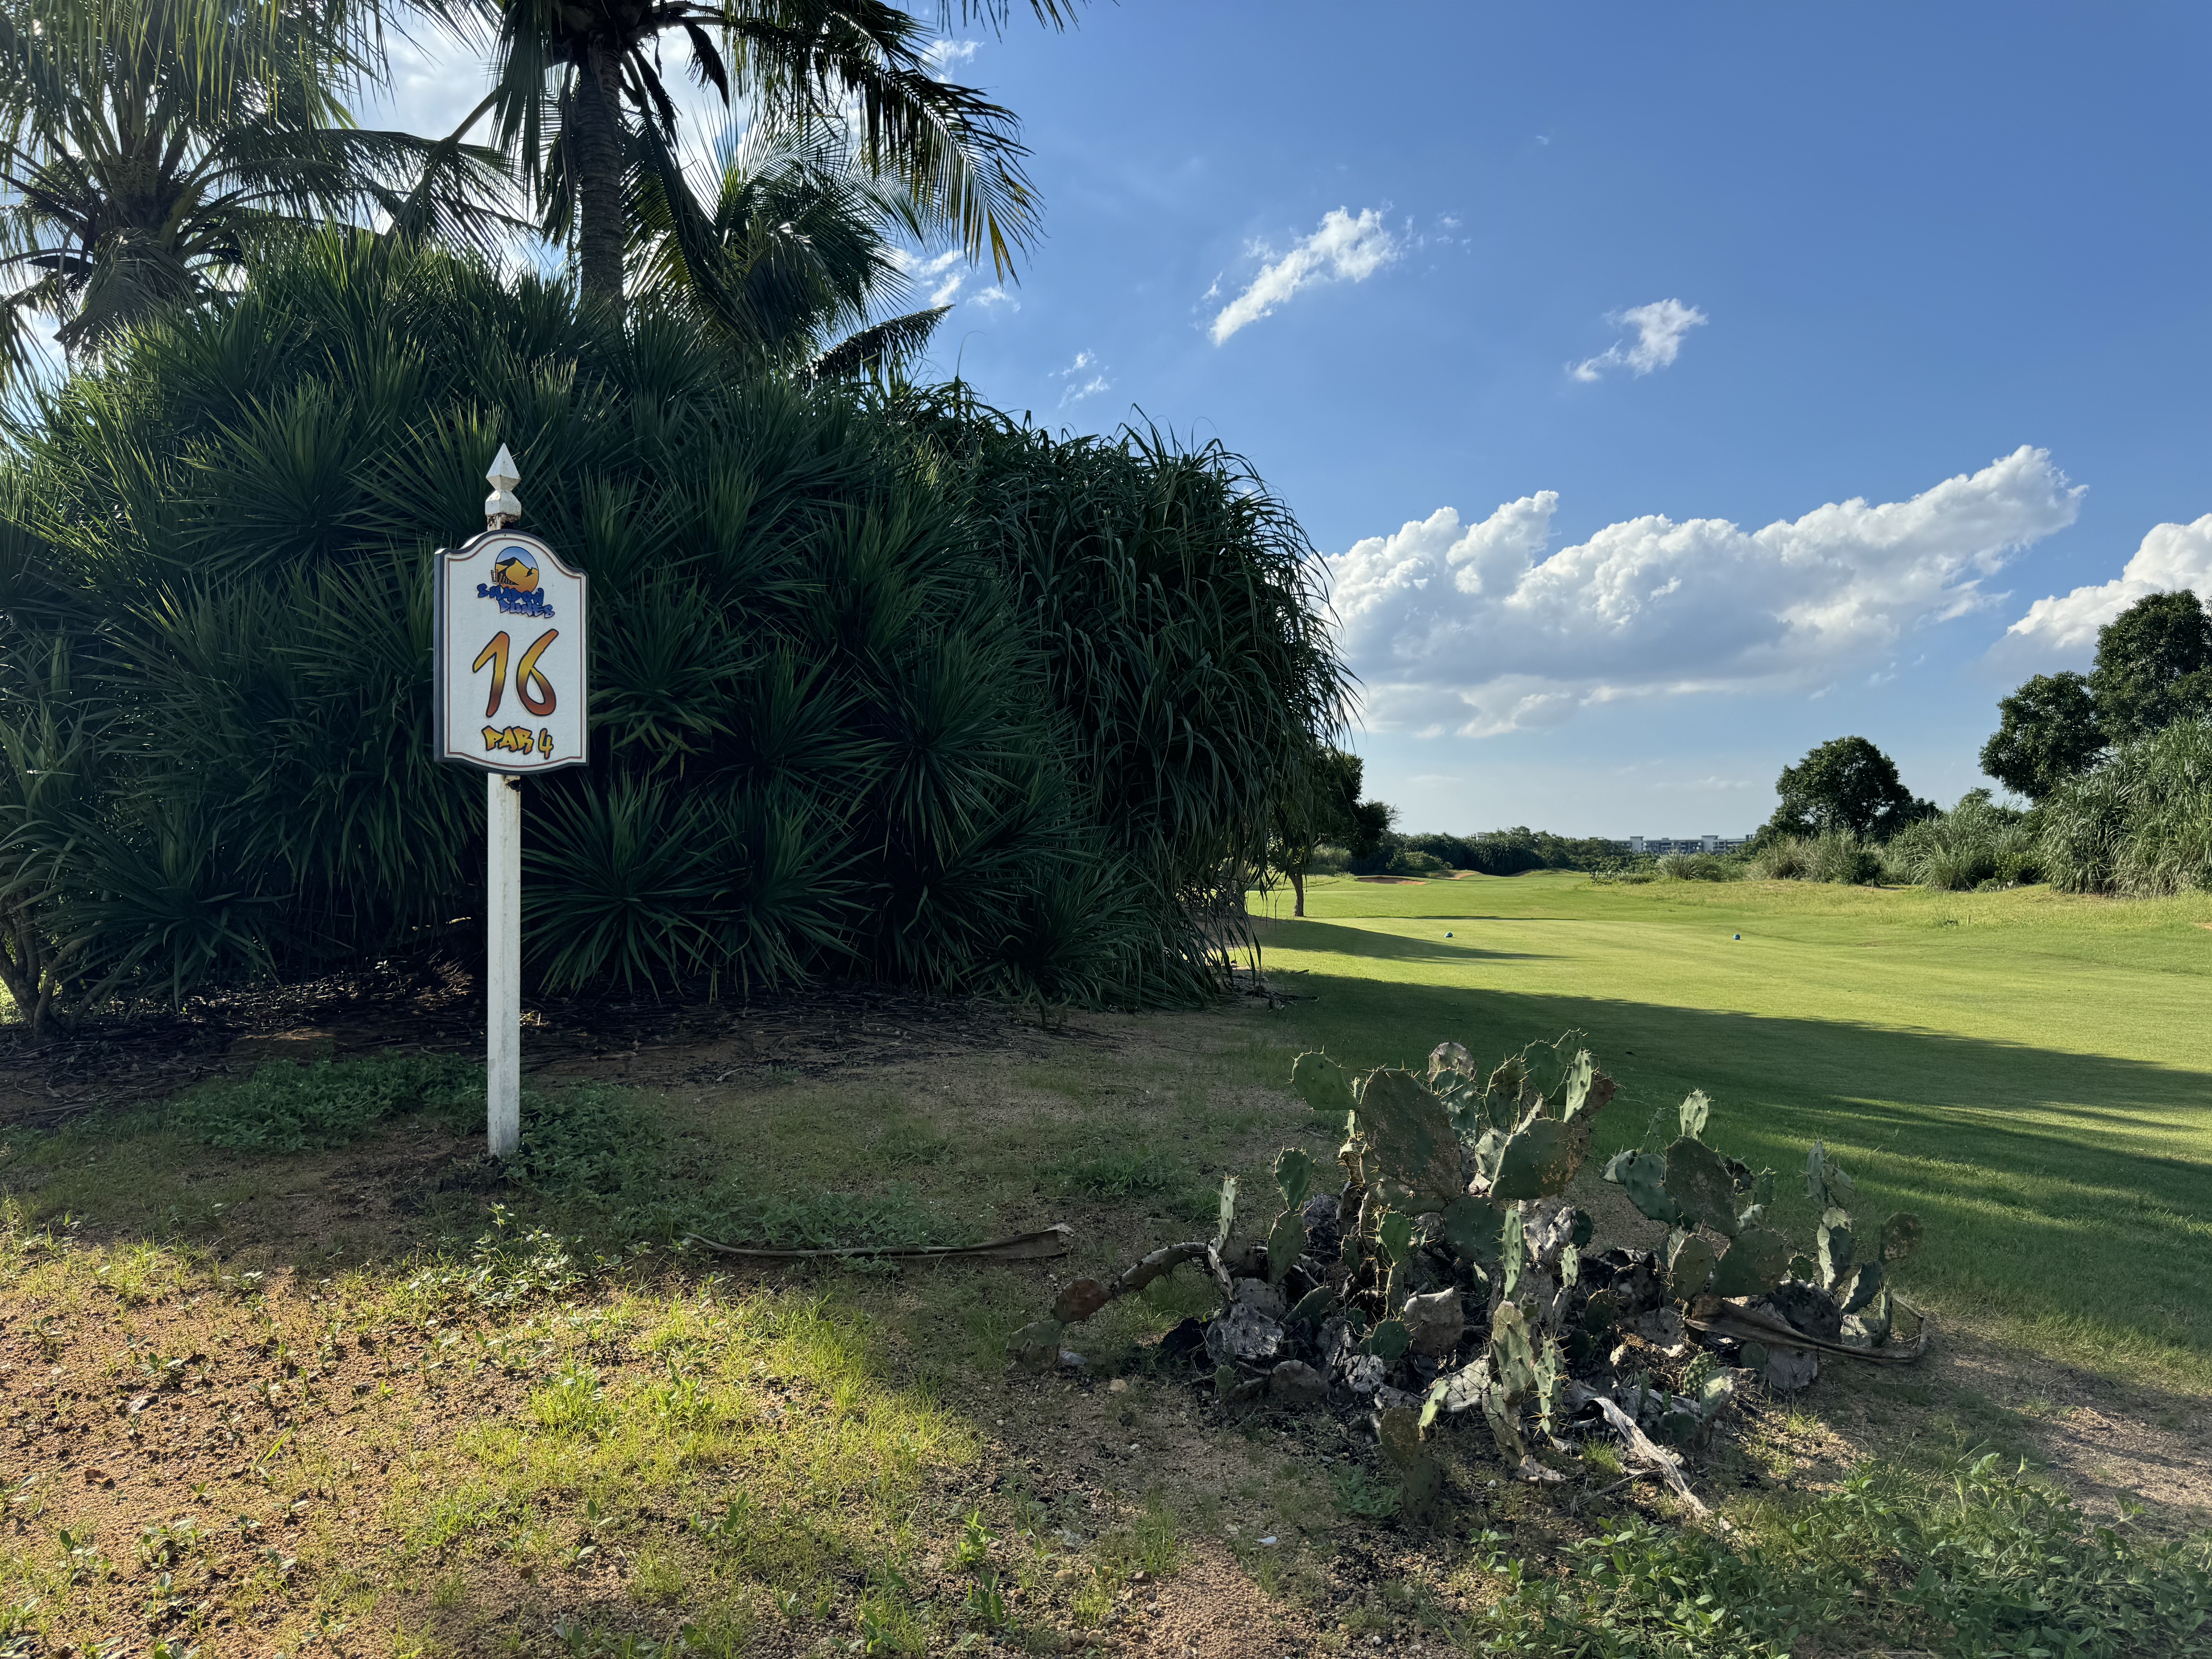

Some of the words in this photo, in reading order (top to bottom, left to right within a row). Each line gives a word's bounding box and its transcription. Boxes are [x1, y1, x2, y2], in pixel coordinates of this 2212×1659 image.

[477, 583, 544, 605] SHADOW
[498, 599, 555, 618] DUNES
[472, 629, 559, 718] 16
[481, 725, 534, 754] PAR
[538, 728, 554, 759] 4
